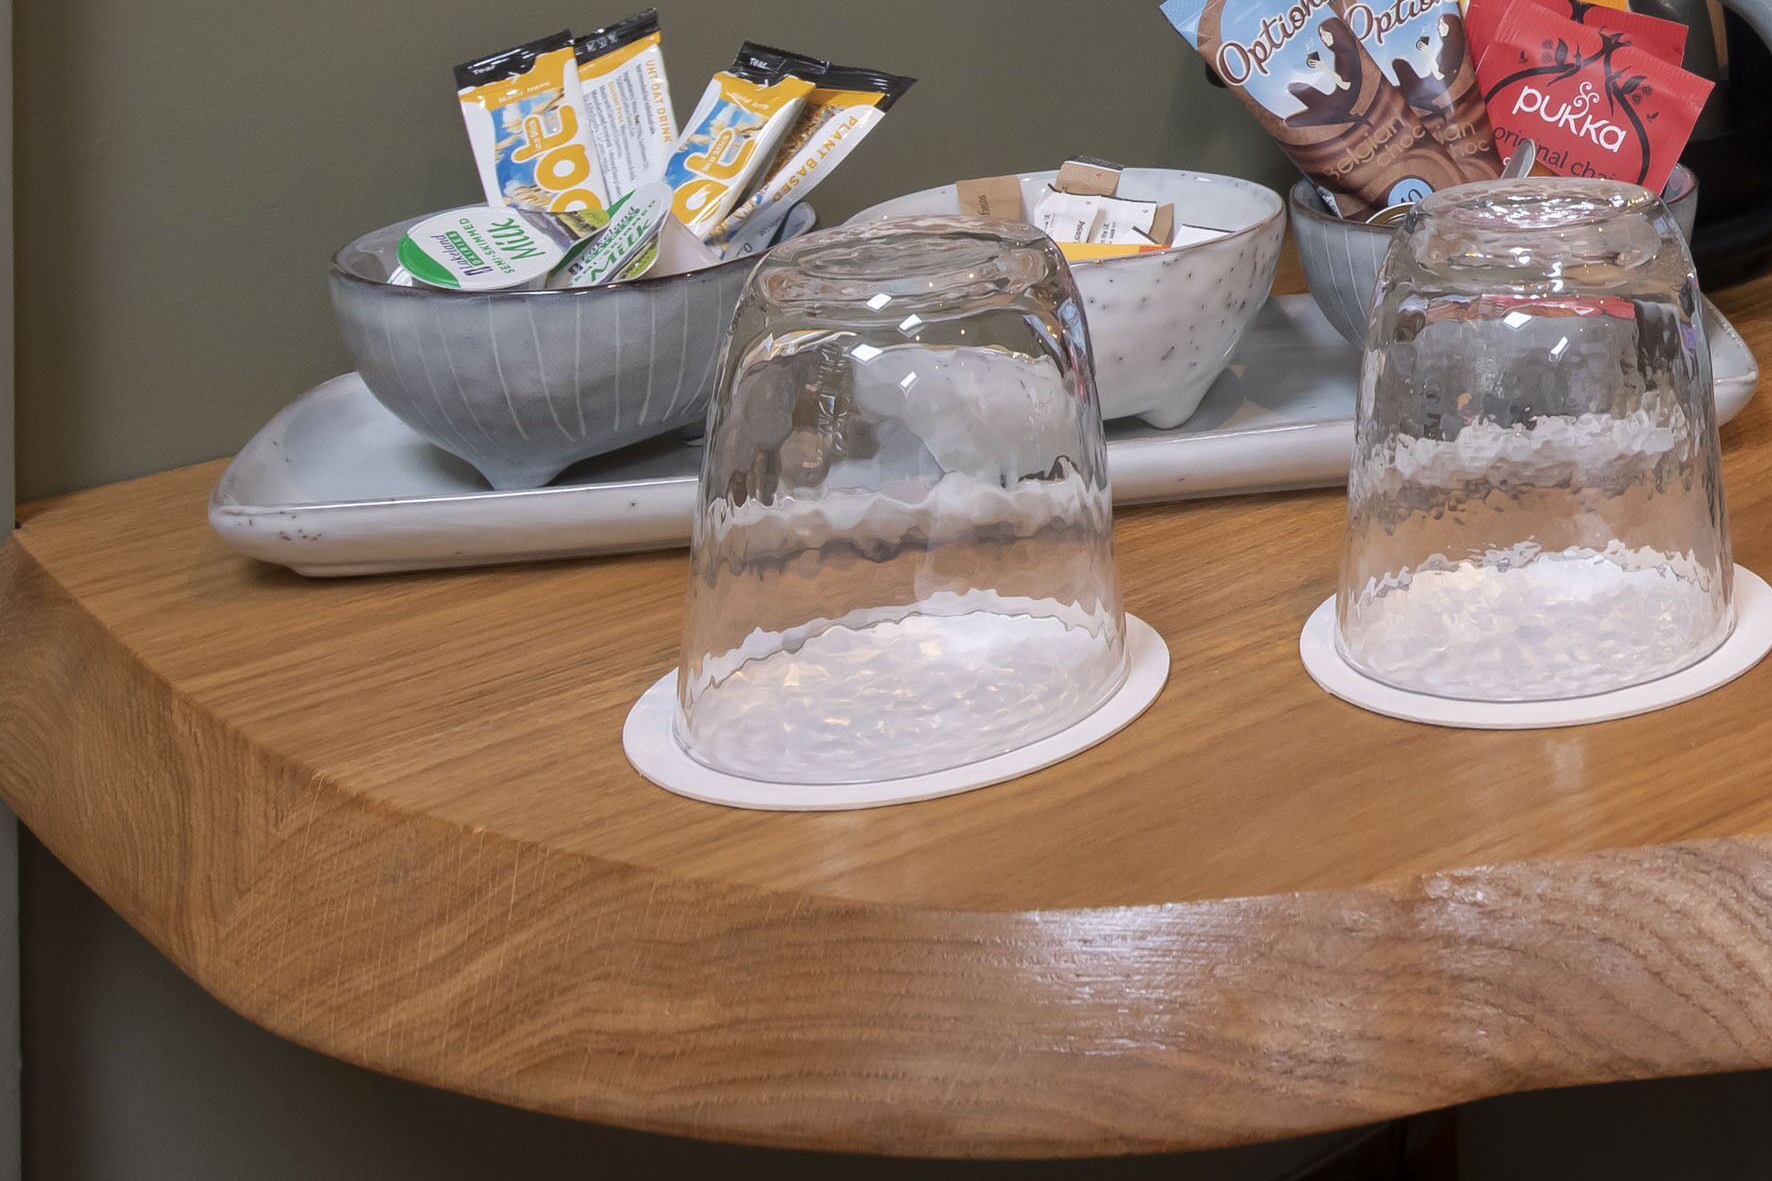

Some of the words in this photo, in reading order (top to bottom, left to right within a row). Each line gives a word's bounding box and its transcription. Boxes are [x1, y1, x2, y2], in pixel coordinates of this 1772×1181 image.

[473, 64, 496, 76] Tear
[749, 57, 768, 68] Tear
[651, 81, 665, 106] OAT
[656, 105, 673, 143] DRINK
[816, 115, 859, 161] PLANT
[1512, 82, 1627, 153] pukka
[1376, 125, 1426, 167] choc
[1492, 126, 1569, 169] orinal
[772, 159, 819, 203] BASED
[431, 234, 470, 270] Lakeland
[459, 218, 516, 274] SEMI-SKIMMED
[487, 217, 546, 260] Milk
[591, 218, 650, 282] Milk
